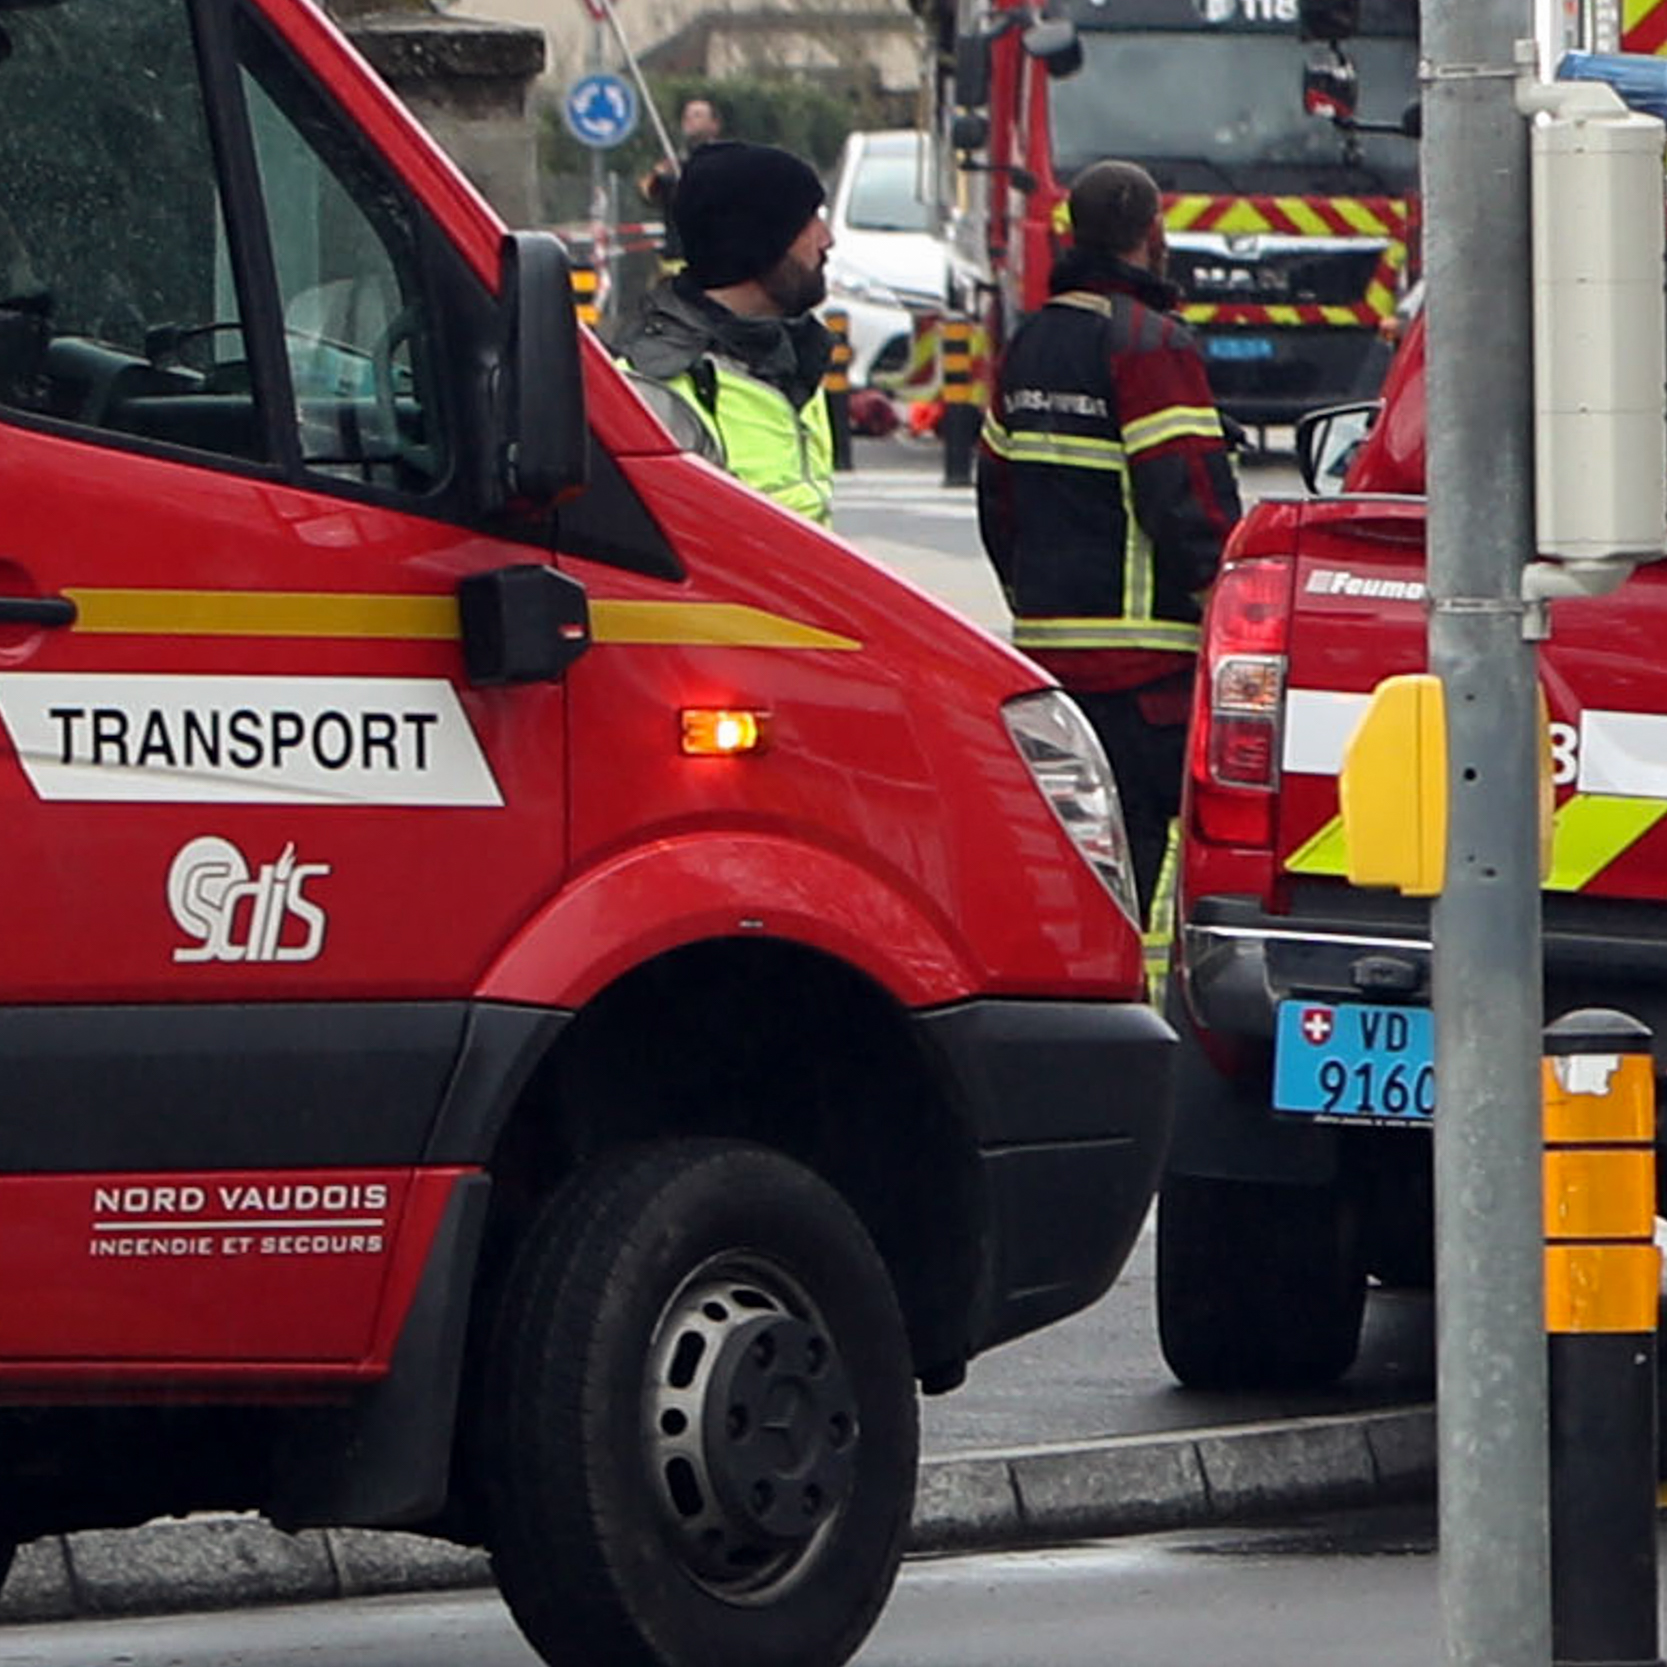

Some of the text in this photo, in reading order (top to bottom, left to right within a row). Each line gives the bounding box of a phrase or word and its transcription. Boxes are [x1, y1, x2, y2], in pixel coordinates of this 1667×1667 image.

[49, 708, 438, 771] TRANSPORT
[1359, 1010, 1409, 1053] VD
[94, 1184, 388, 1213] NORD VAUDOIS
[89, 1234, 384, 1256] INCENDIE ET SECOURS
